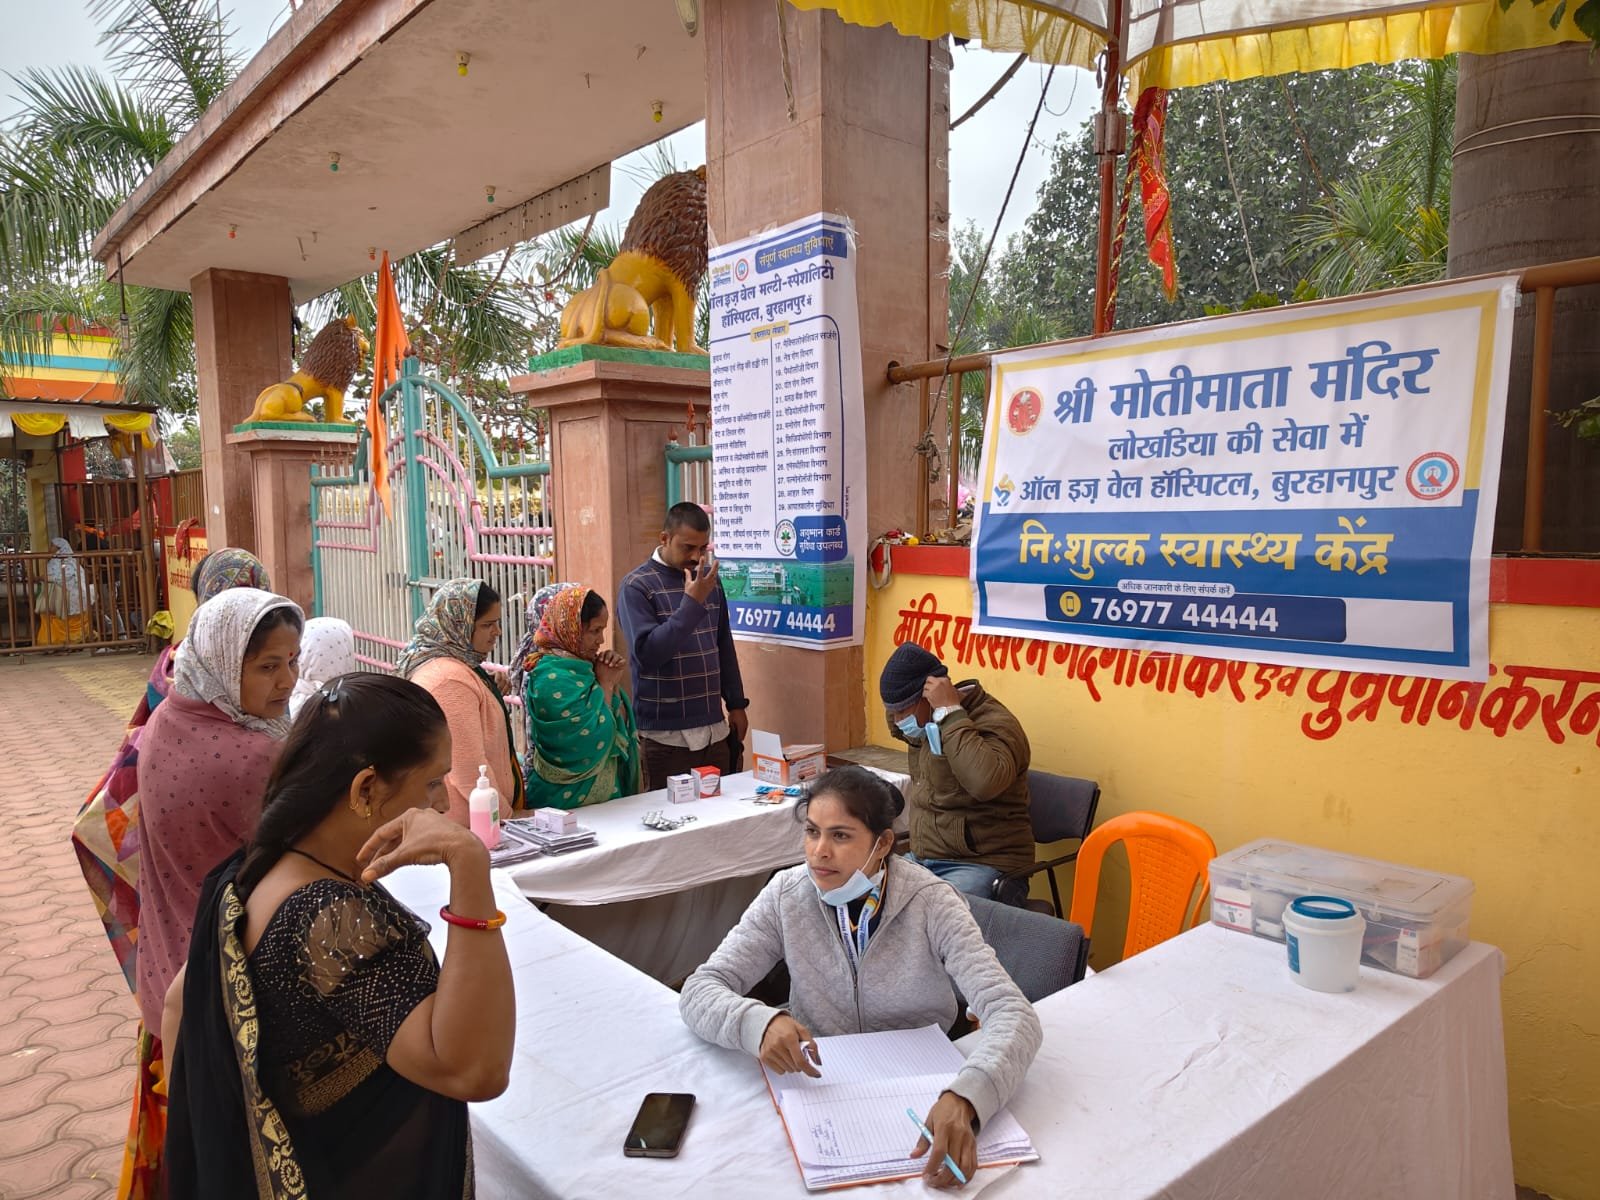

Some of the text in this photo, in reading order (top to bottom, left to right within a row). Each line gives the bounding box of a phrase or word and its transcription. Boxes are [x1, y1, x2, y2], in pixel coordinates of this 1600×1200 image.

[740, 284, 756, 300] वेल
[760, 260, 834, 296] मल्टी-स्पेशलिटी
[722, 308, 763, 328] हॉस्पिटल,
[766, 294, 806, 322] बुरहानपुर
[1053, 340, 1440, 424] श्री मोतीमाता मंदिर
[1108, 412, 1370, 460] लोखंडिया की सेवा में
[1020, 476, 1062, 500] ऑल
[1068, 478, 1100, 504] इज़
[1107, 470, 1143, 499] वेल
[1150, 467, 1260, 500] हॉस्पिटल,
[1272, 466, 1399, 502] बुरहानपुर
[826, 524, 841, 536] कार्ड
[1160, 532, 1302, 570] स्वास्थ्य
[1314, 515, 1395, 576] केंद्र
[1121, 581, 1142, 590] अधिक
[1143, 583, 1173, 592] जानकारी
[1174, 584, 1181, 592] के
[1183, 584, 1197, 594] लिए
[1198, 585, 1217, 594] संपर्क
[736, 608, 836, 632] 76977 44444
[893, 592, 952, 660] मंदिर
[1090, 597, 1279, 632] 76977 44444
